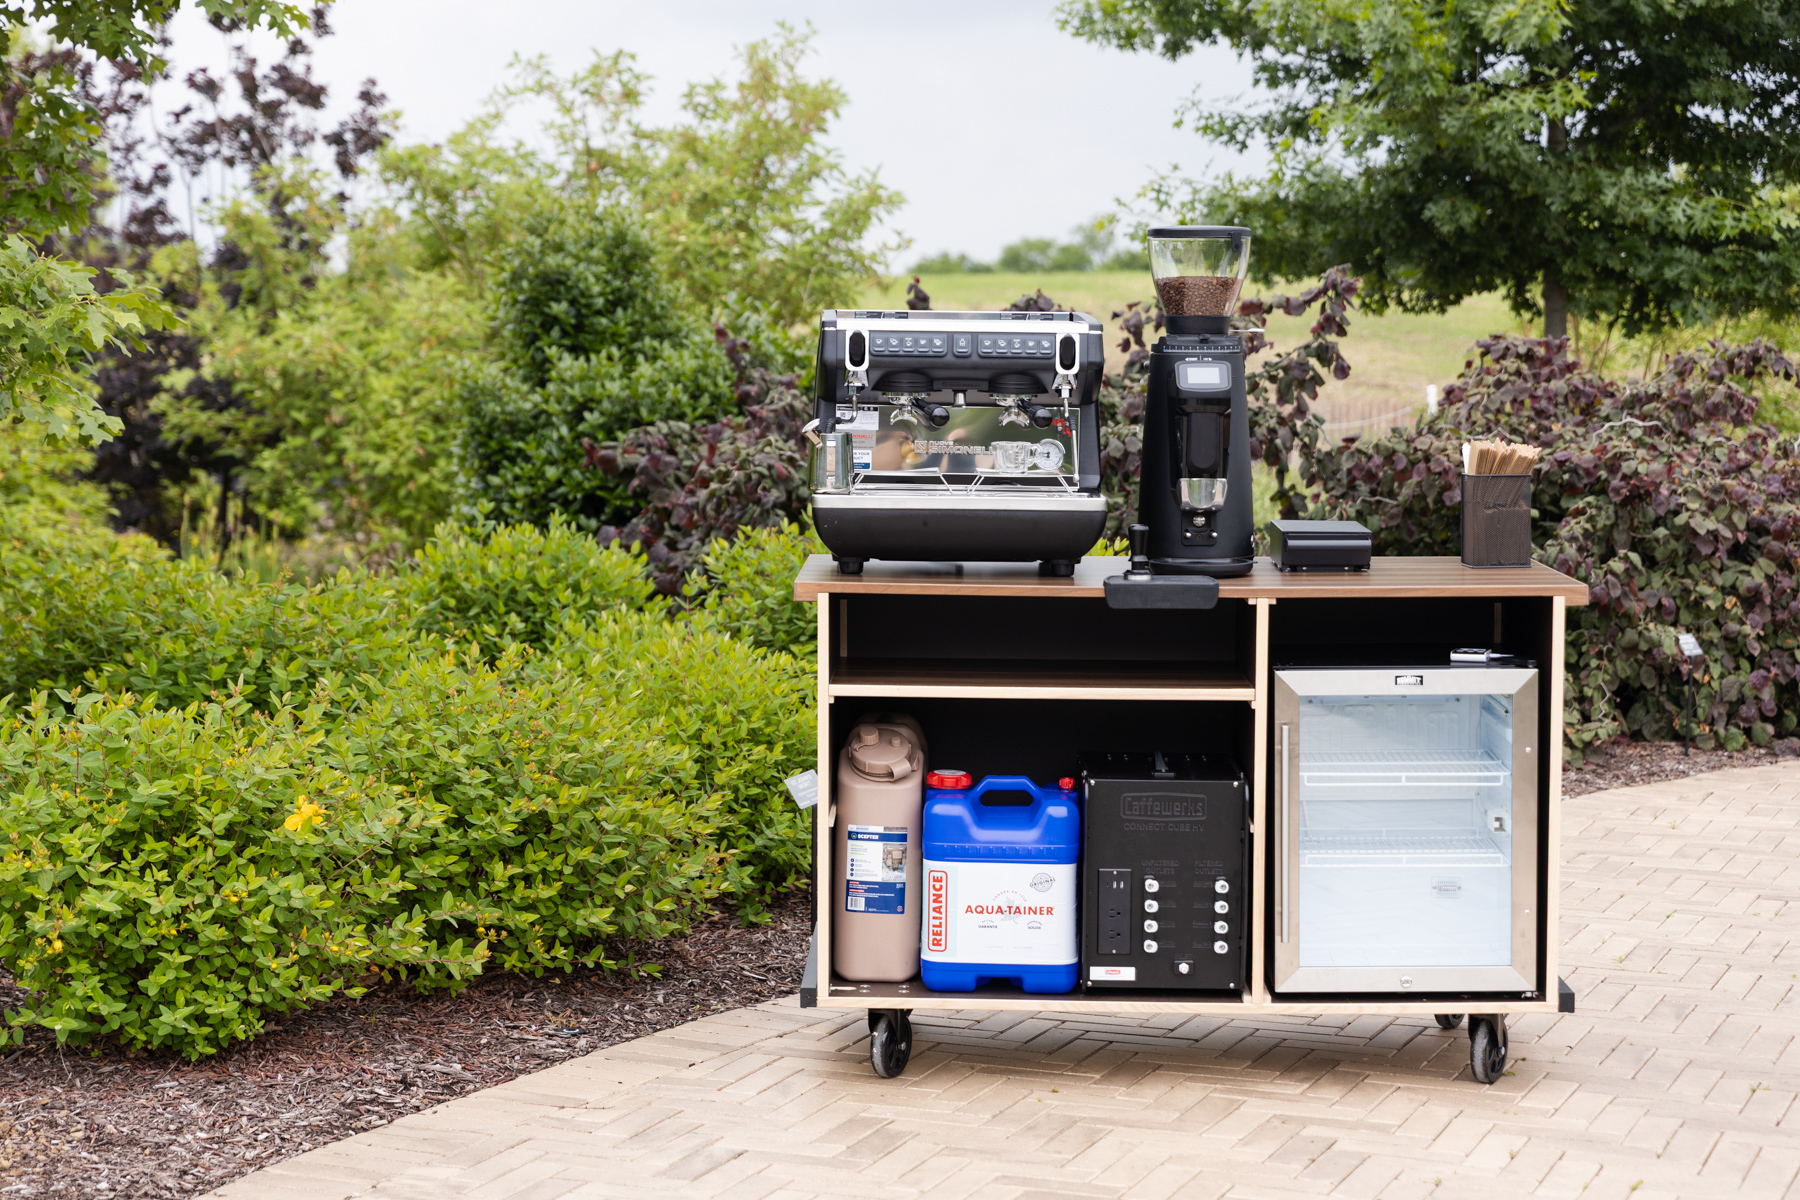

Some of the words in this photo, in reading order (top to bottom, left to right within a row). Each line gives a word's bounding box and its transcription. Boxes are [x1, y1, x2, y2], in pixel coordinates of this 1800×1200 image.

[928, 445, 994, 455] SIMONELL
[1124, 797, 1204, 816] Caffewerks
[1123, 822, 1165, 831] CONNECT
[1167, 823, 1191, 832] CUBE
[1192, 823, 1205, 832] HV
[1145, 867, 1175, 875] OUTLETS
[1194, 867, 1224, 875] OUTLETS
[1029, 877, 1056, 888] ORIGINAL
[931, 875, 943, 947] RELIANCE
[964, 904, 1054, 916] AQUA-TAINER
